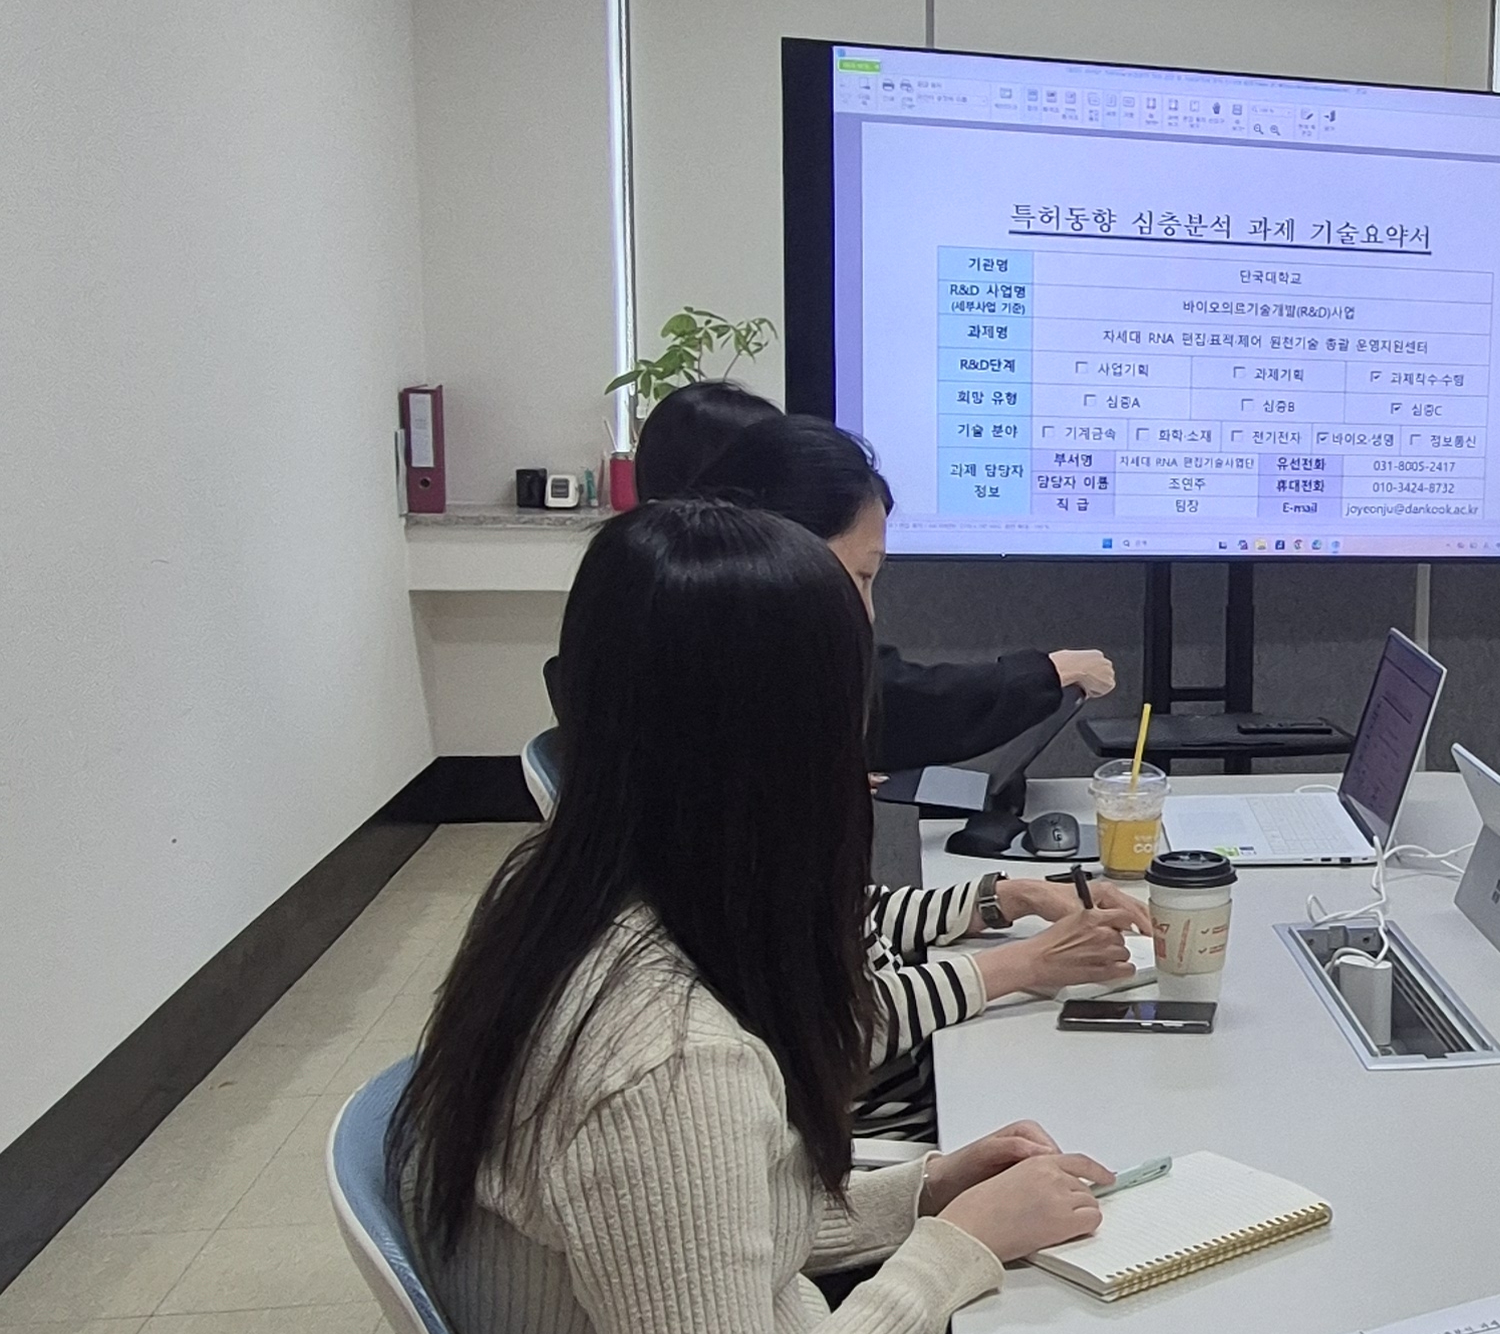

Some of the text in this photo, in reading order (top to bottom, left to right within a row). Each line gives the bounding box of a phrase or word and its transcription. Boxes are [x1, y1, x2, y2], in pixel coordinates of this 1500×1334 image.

[1010, 204, 1430, 250] 특허동향 심층분석 과제 기술요약서
[968, 257, 1009, 272] 기관명
[1239, 270, 1302, 285] 단국대학교
[949, 284, 1026, 299] R&D 사업명
[951, 300, 1026, 315] (세부사업 기준)
[967, 324, 1009, 339] 과제명
[1148, 332, 1175, 344] RNA
[1269, 336, 1319, 351] 원천기술
[1356, 339, 1429, 354] 운영지원센터
[959, 359, 1016, 373] R&D단계
[1097, 363, 1150, 377] 사업기획
[1253, 367, 1304, 382] 과제기획
[956, 390, 1018, 406] 희망 유형
[957, 423, 1019, 439] 기술 분야
[1252, 430, 1302, 445] 전기전자
[1430, 434, 1478, 449] 정보통신
[1053, 453, 1094, 467] 부서명
[1155, 457, 1179, 468] RNA
[1276, 456, 1327, 472] 유선전화
[1372, 460, 1457, 473] 031-8005-2417
[949, 462, 1025, 478] 과제 담당자
[1037, 475, 1110, 491] 담당자 이름
[1168, 477, 1207, 492] 조연주
[1276, 479, 1326, 494] 휴대전화
[1371, 481, 1456, 495] 010-3424-8732
[974, 484, 1002, 499] 정보
[1056, 498, 1090, 513] 직 급
[1175, 498, 1200, 514] 팀장
[1281, 501, 1319, 515] E-mail
